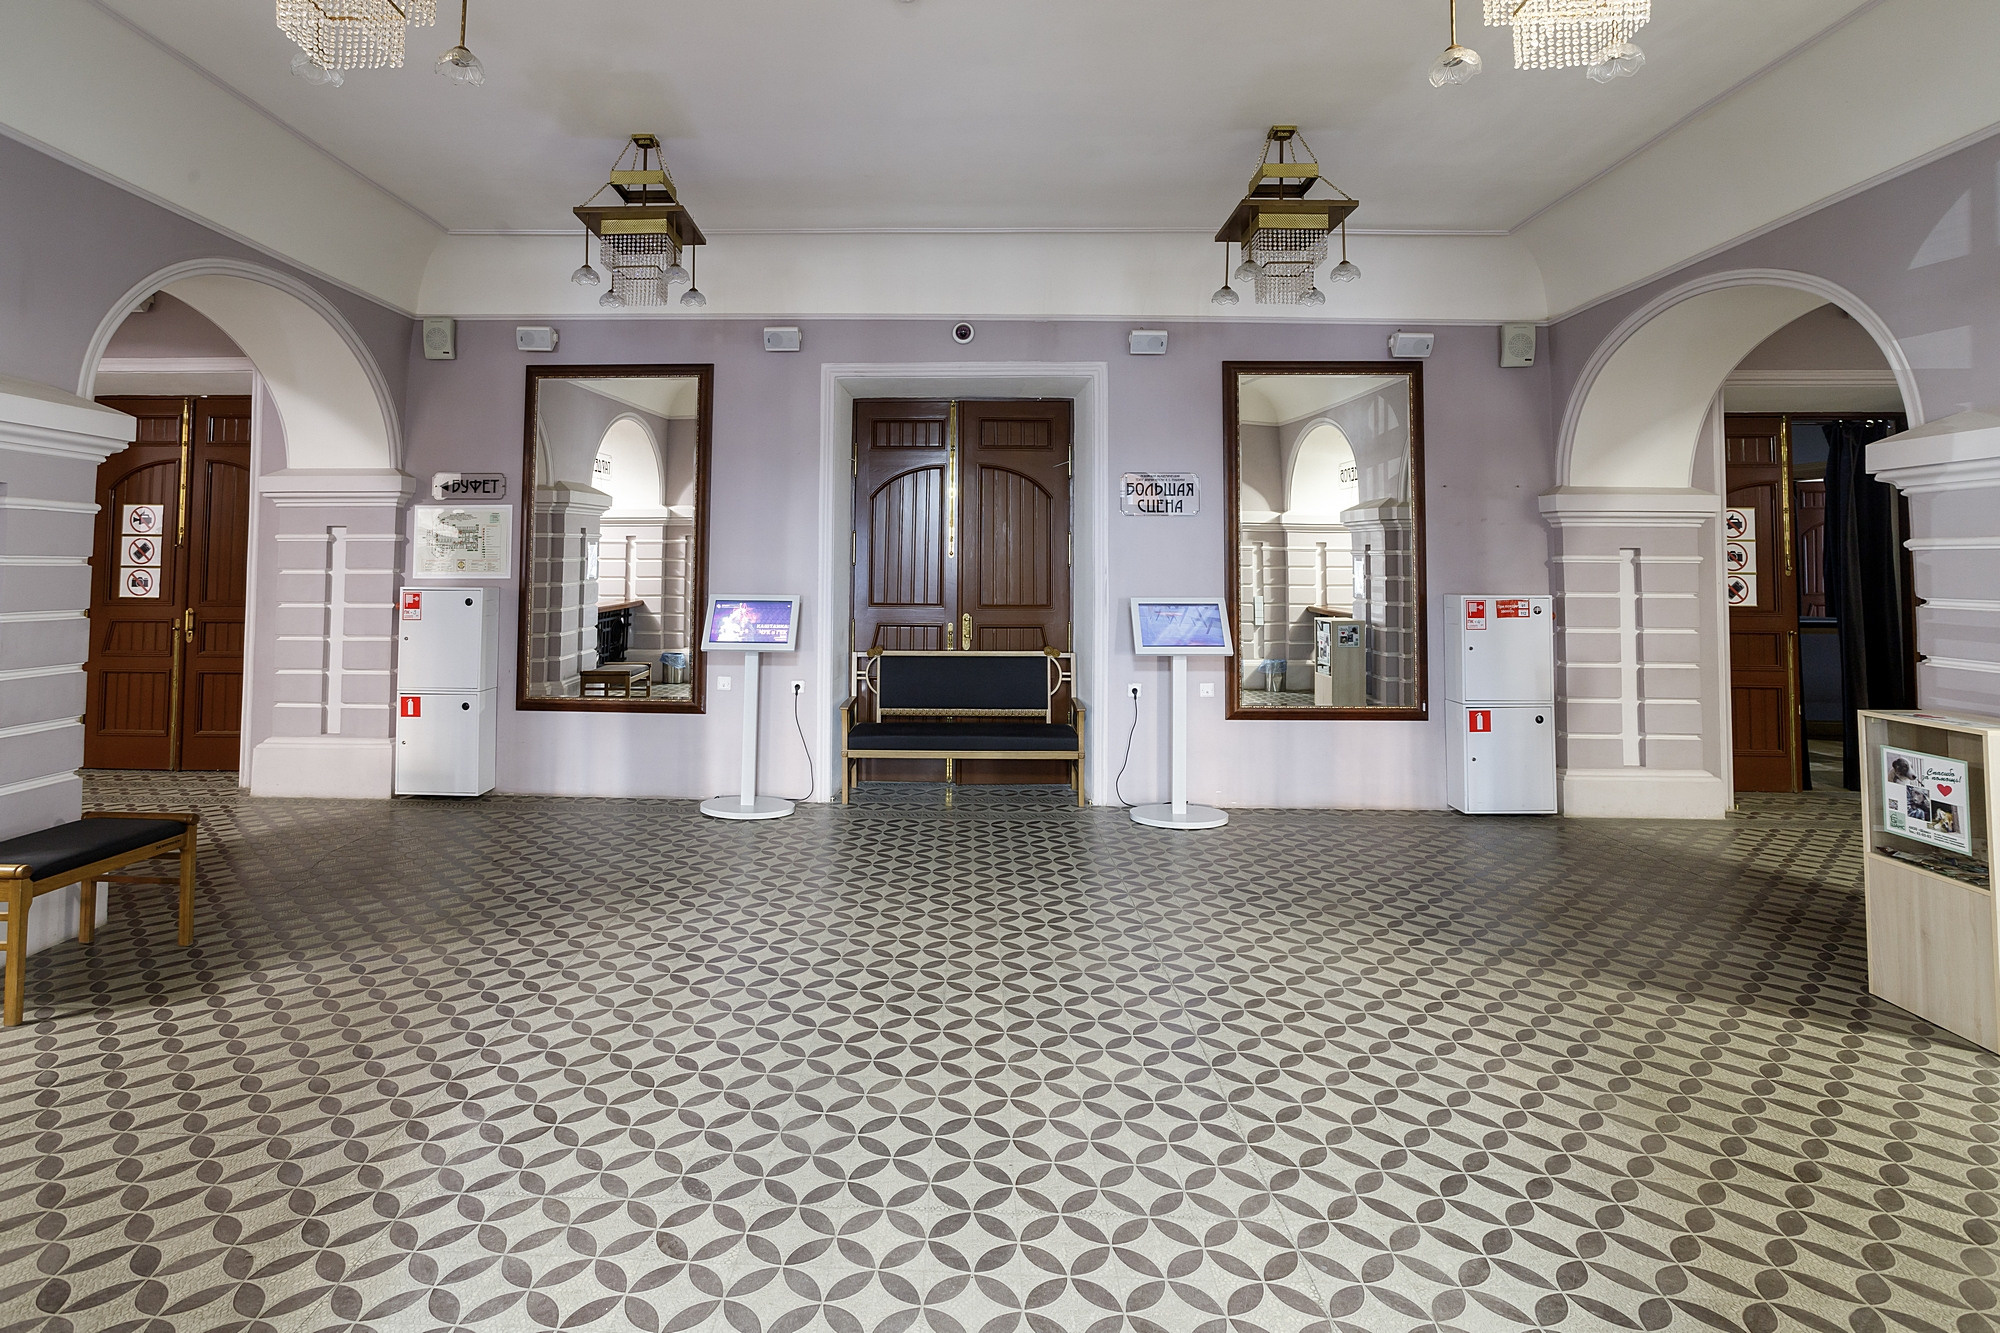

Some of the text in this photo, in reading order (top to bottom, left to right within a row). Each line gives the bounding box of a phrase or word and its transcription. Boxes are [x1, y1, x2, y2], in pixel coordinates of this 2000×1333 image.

[452, 479, 500, 493] БУФЕТ
[1126, 482, 1194, 496] БОЛЬШАЯ
[1137, 499, 1183, 513] СЦЕНА
